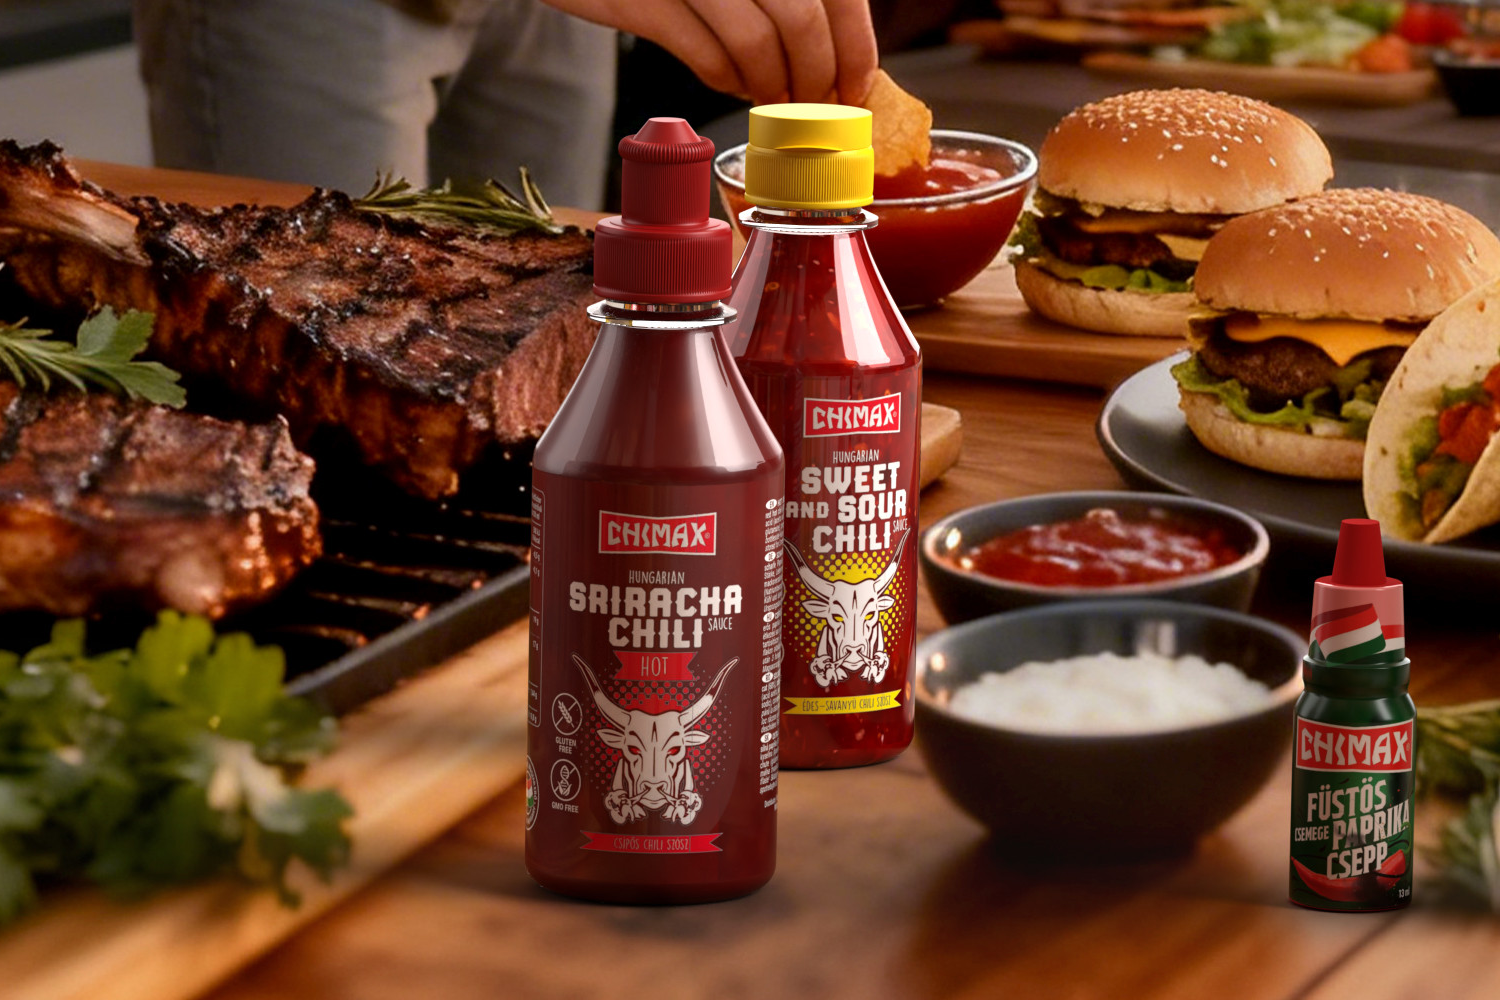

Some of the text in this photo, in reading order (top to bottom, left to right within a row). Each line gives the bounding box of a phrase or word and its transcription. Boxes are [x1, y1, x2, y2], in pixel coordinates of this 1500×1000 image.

[812, 401, 895, 431] CHIMAX
[832, 448, 880, 464] HUNGARIAN
[800, 461, 901, 495] SWEET
[785, 488, 907, 523] AND SOUR
[607, 520, 707, 548] CHIMAX
[812, 521, 891, 553] CHILI
[892, 517, 909, 533] SAUCE
[628, 569, 685, 585] HUNGARIAN
[569, 580, 743, 618] SRIRACHA
[607, 616, 704, 649] CHILI
[707, 616, 733, 632] SAUCE
[640, 655, 669, 677] HOT
[555, 736, 577, 747] GLUTEN
[558, 745, 573, 755] FREE
[1300, 727, 1409, 766] CHIMAX
[551, 801, 579, 814] GMO FREE
[1306, 776, 1387, 823] FÜSTÖS
[1294, 799, 1410, 850] CSEMEGE PAPRIKA
[643, 838, 664, 851] CHILI
[1326, 841, 1388, 881] CSEPP
